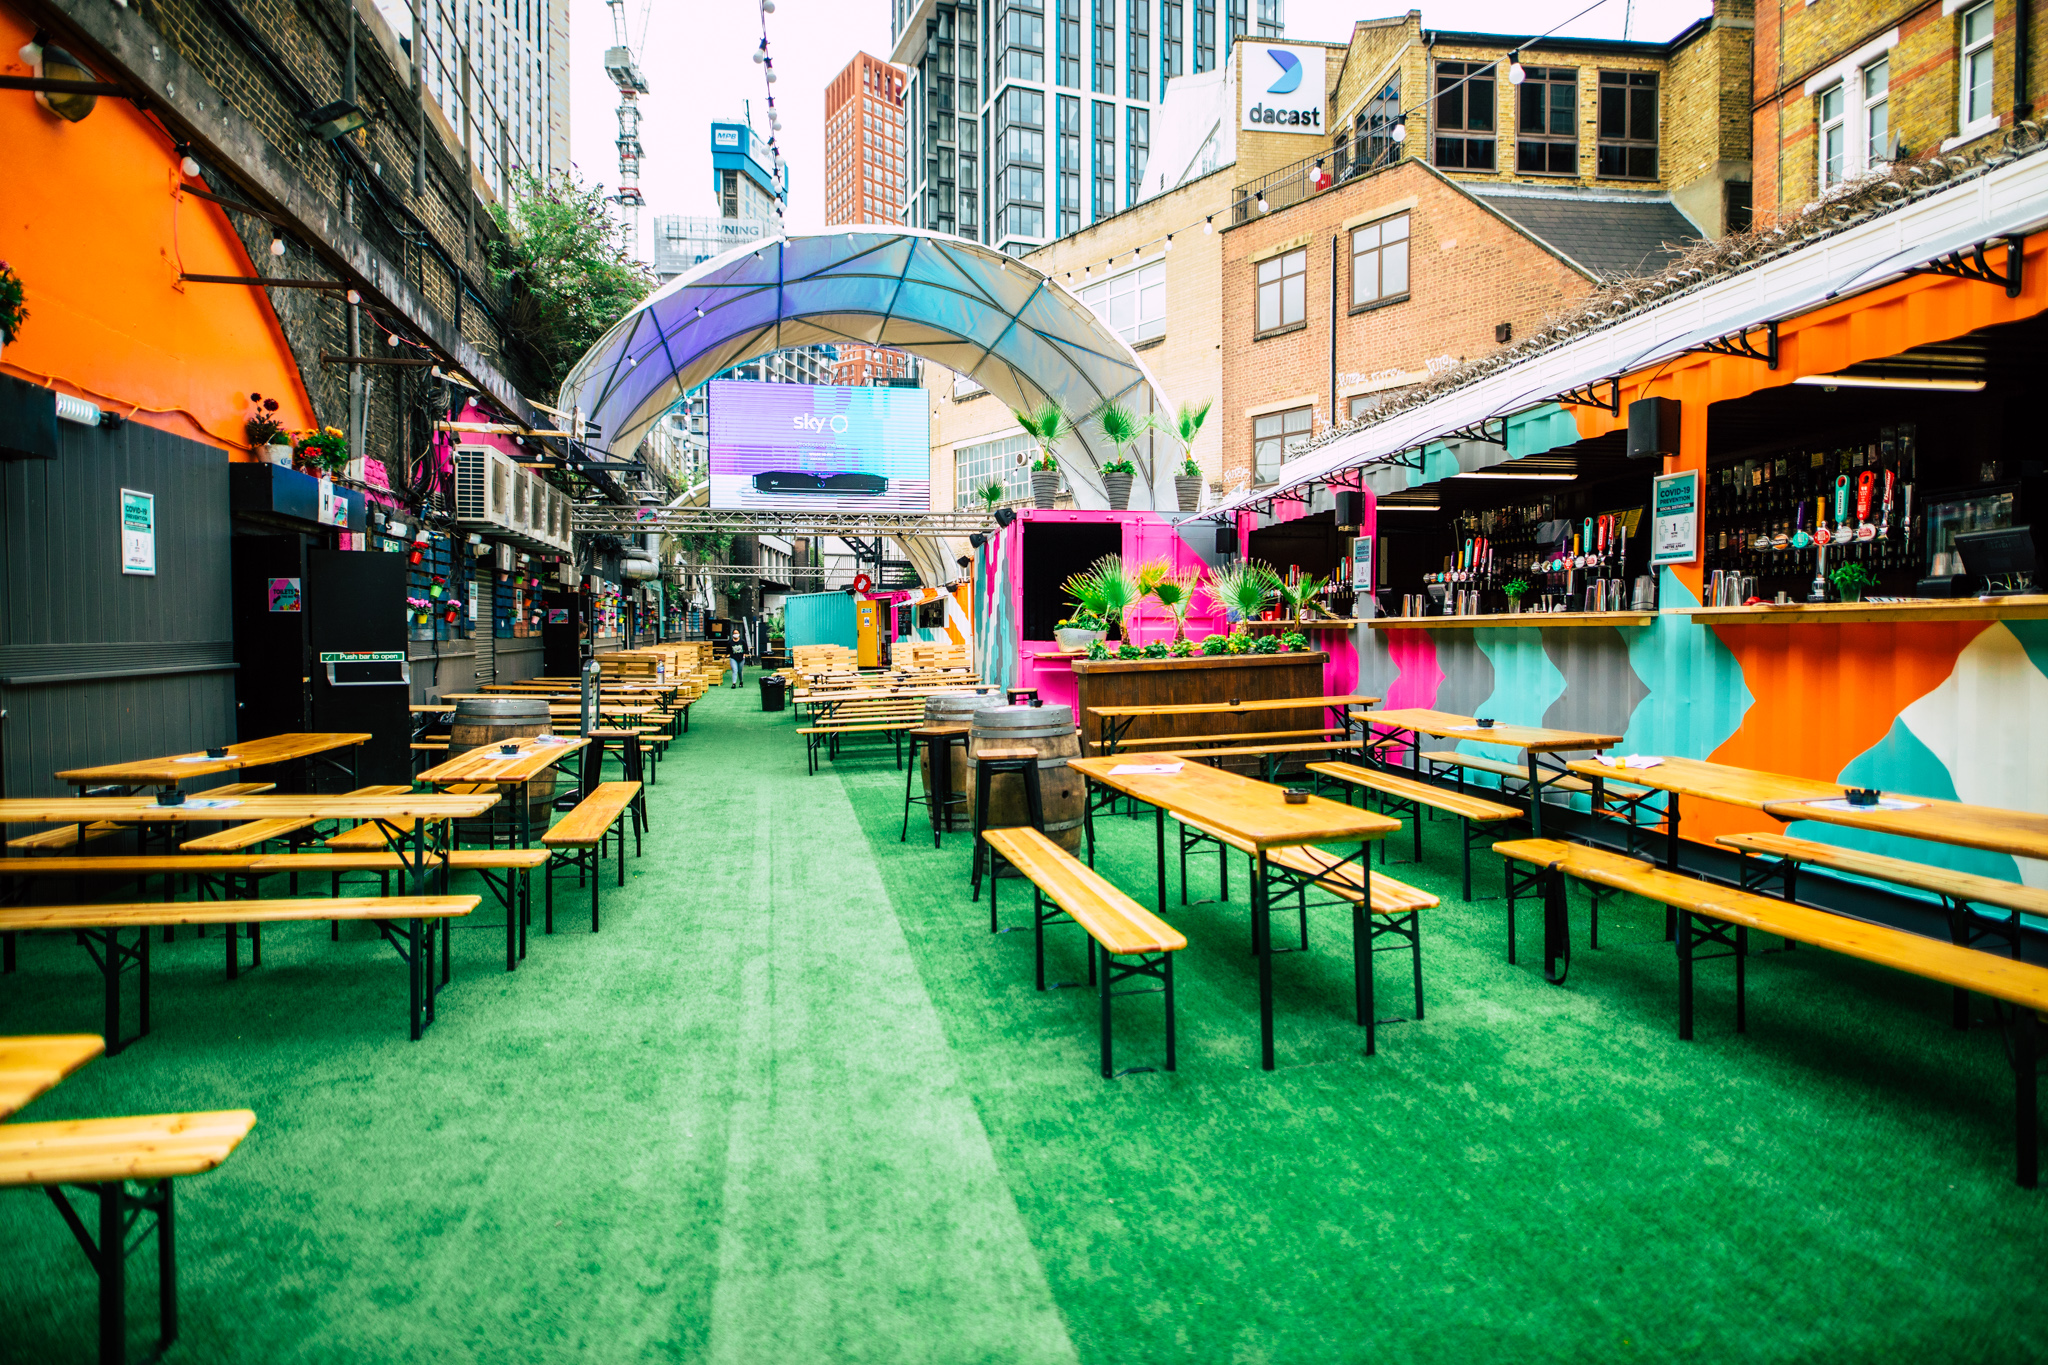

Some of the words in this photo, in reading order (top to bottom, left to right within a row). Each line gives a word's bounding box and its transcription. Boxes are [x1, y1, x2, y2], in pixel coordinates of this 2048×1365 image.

[1249, 102, 1320, 126] dacast
[717, 132, 737, 140] MPB
[793, 412, 826, 433] sky
[829, 414, 848, 433] Q
[1660, 486, 1691, 498] COVID-19
[324, 493, 329, 511] H
[1660, 495, 1691, 505] PREVENTION
[125, 505, 148, 516] COVID-19
